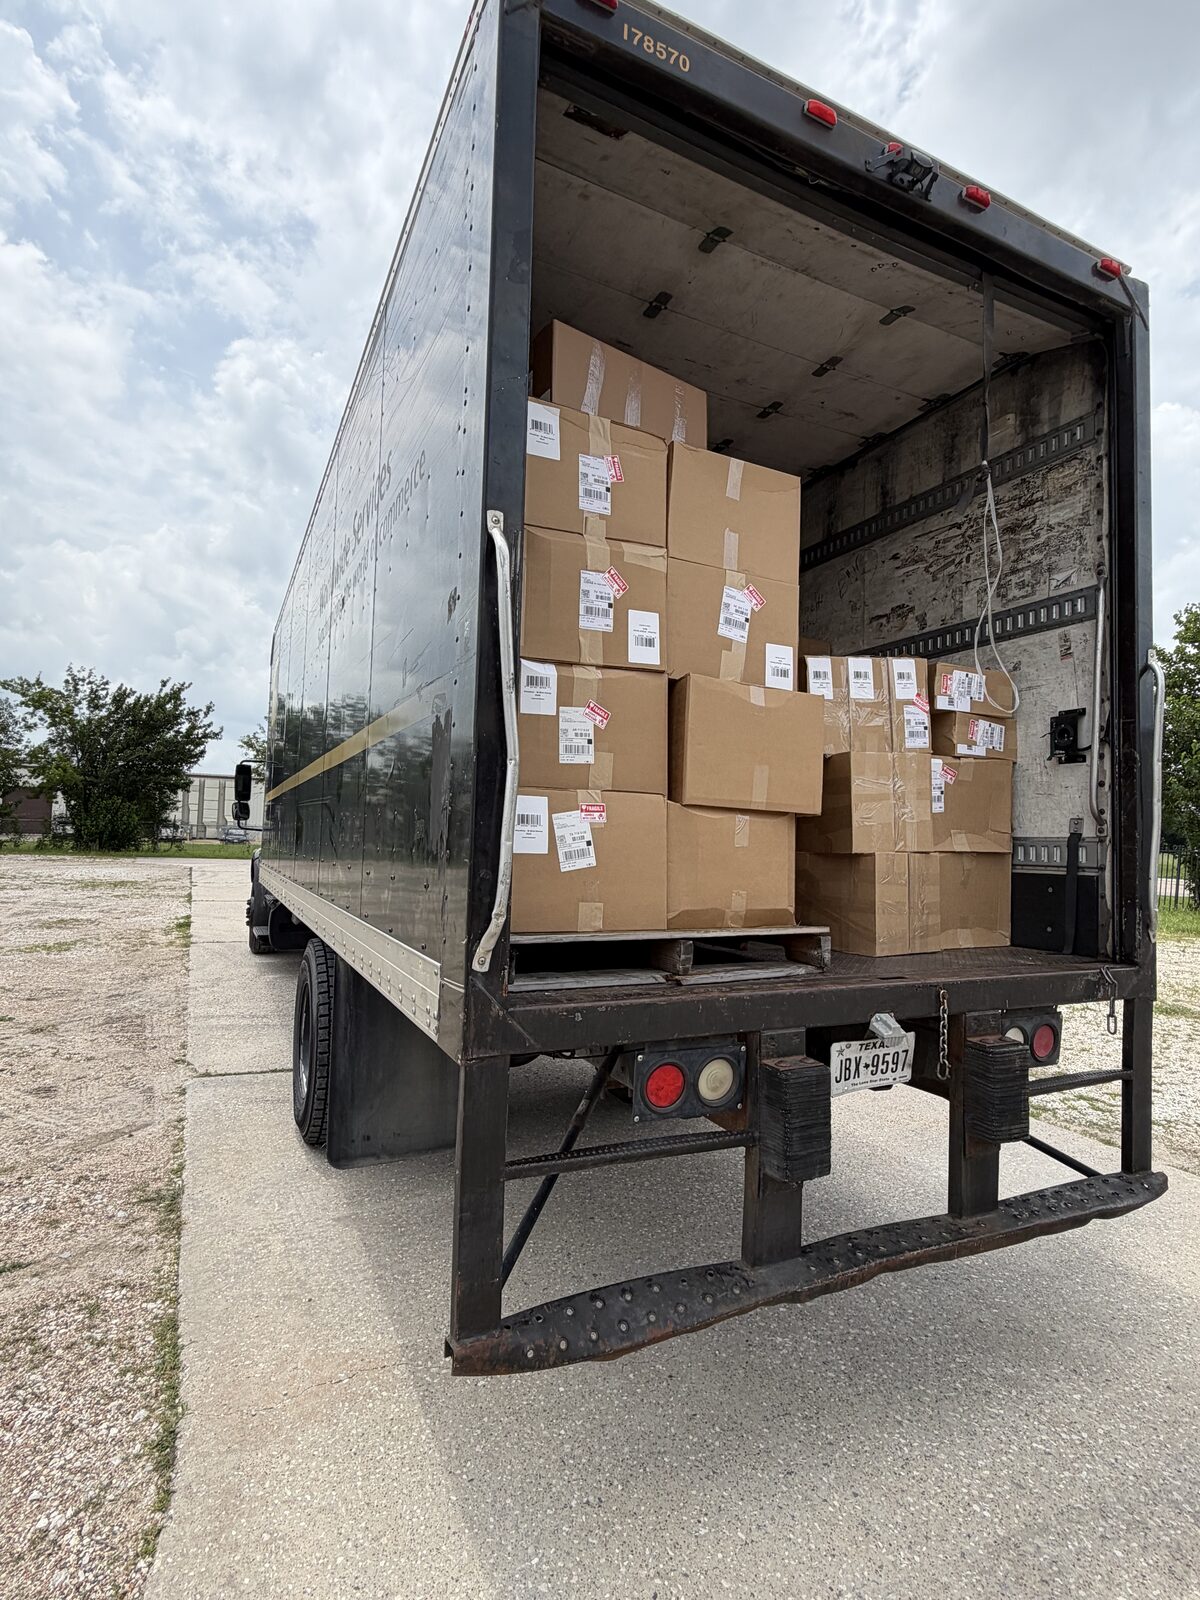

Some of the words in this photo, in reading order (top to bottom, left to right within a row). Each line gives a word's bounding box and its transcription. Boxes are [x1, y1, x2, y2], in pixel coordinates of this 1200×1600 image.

[623, 23, 690, 73] 178570
[378, 449, 426, 547] commerce
[835, 1056, 862, 1084] JBX
[870, 1050, 910, 1076] 9597
